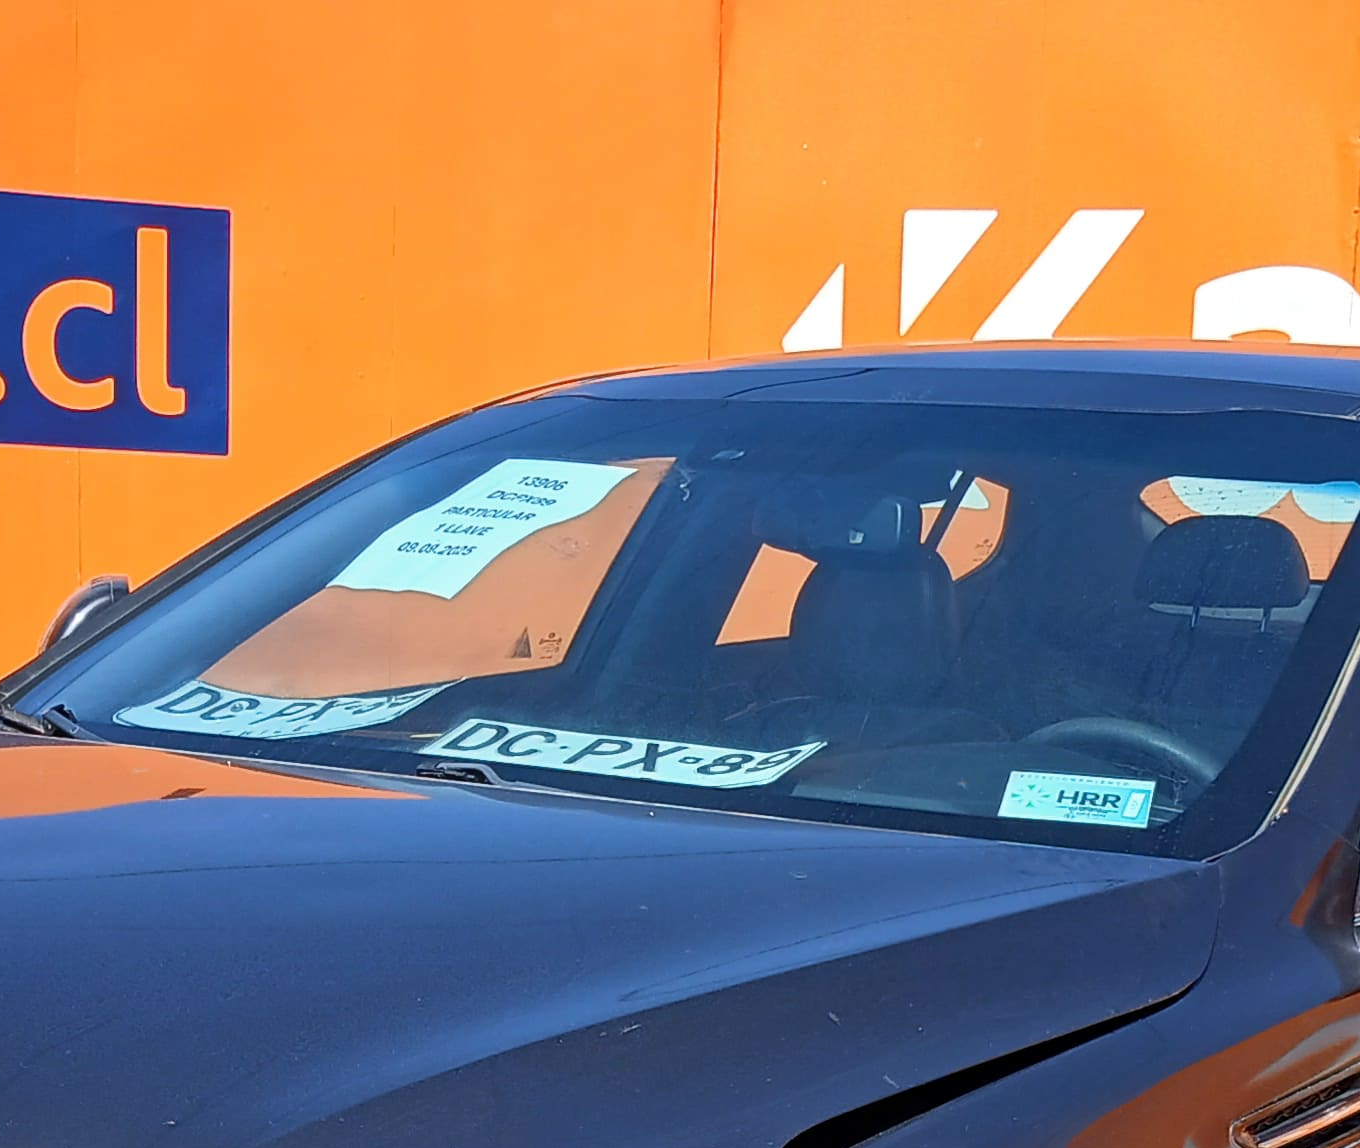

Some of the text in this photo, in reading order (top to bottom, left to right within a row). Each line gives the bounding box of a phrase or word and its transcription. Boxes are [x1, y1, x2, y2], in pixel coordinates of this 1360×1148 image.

[441, 506, 537, 522] PARTICULAR
[443, 523, 495, 536] LLAVE
[1056, 789, 1122, 809] HRR
